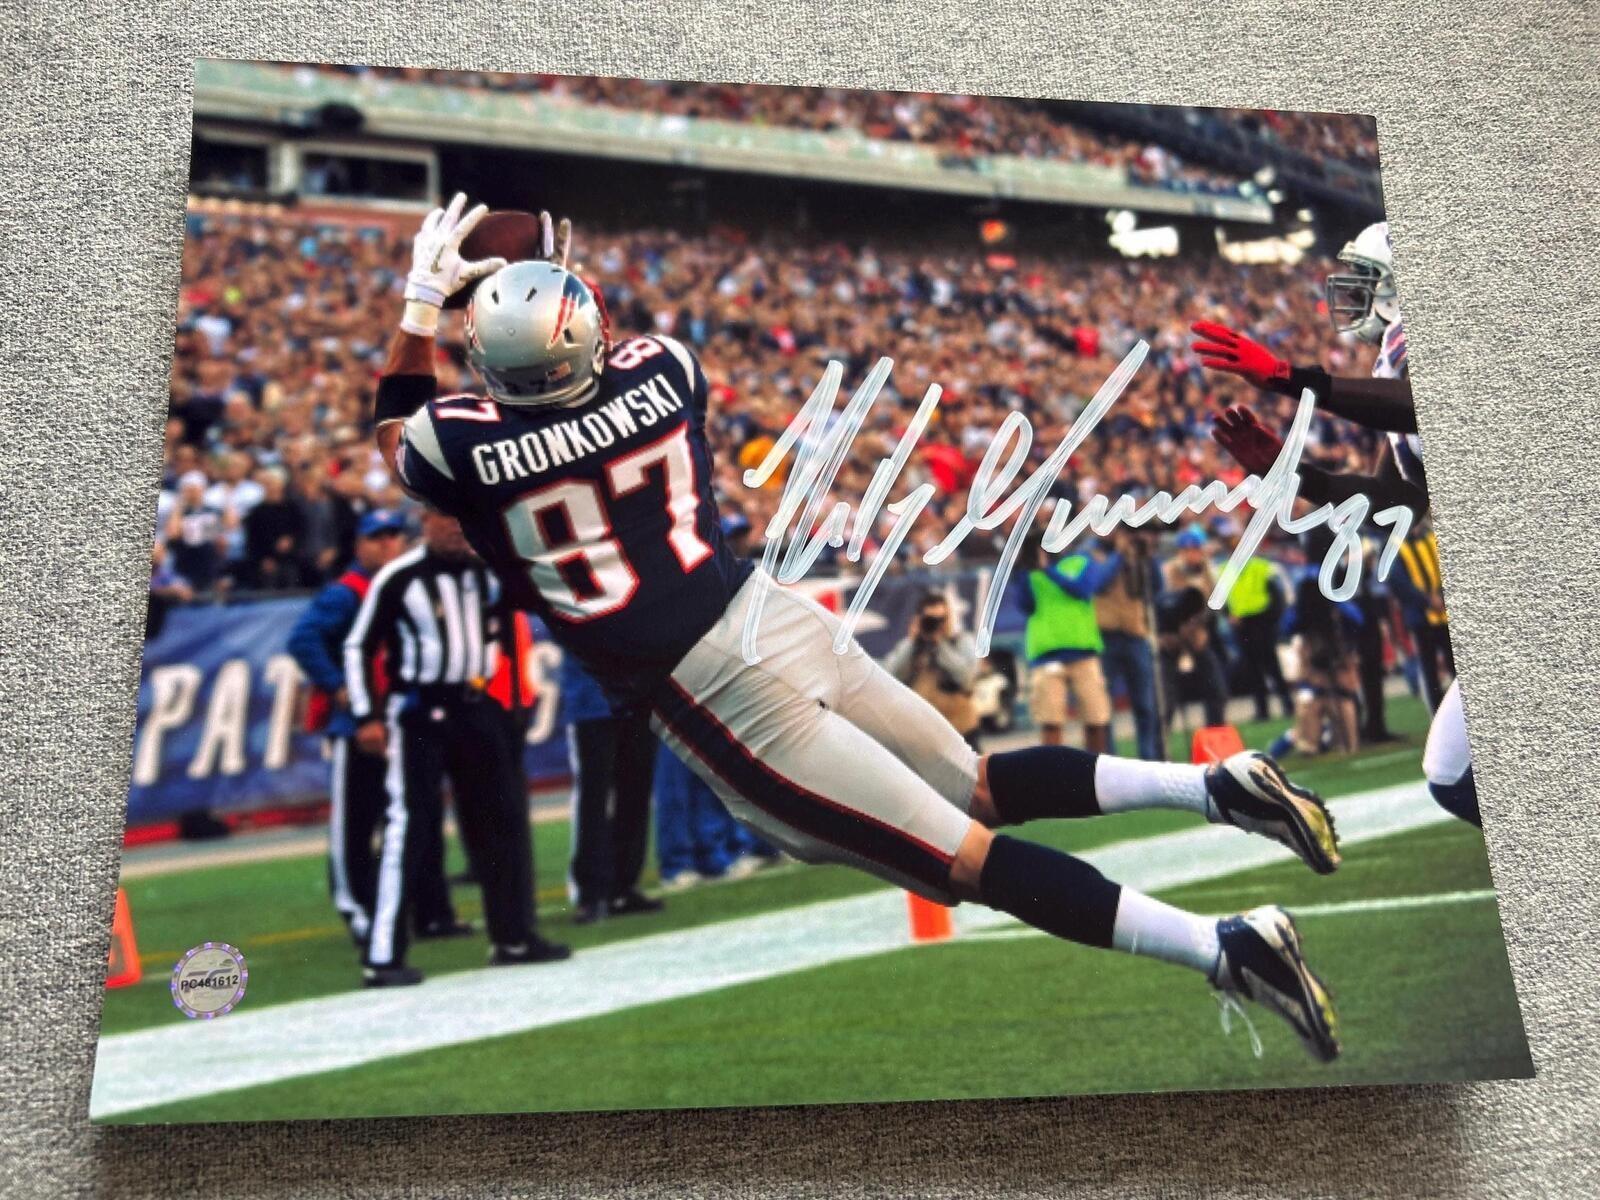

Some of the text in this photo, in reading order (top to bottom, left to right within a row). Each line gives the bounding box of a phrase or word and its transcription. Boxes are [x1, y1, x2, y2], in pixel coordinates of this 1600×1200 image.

[471, 373, 684, 486] GRONKOWSKI
[503, 420, 715, 623] 87
[180, 974, 239, 991] PC481612
